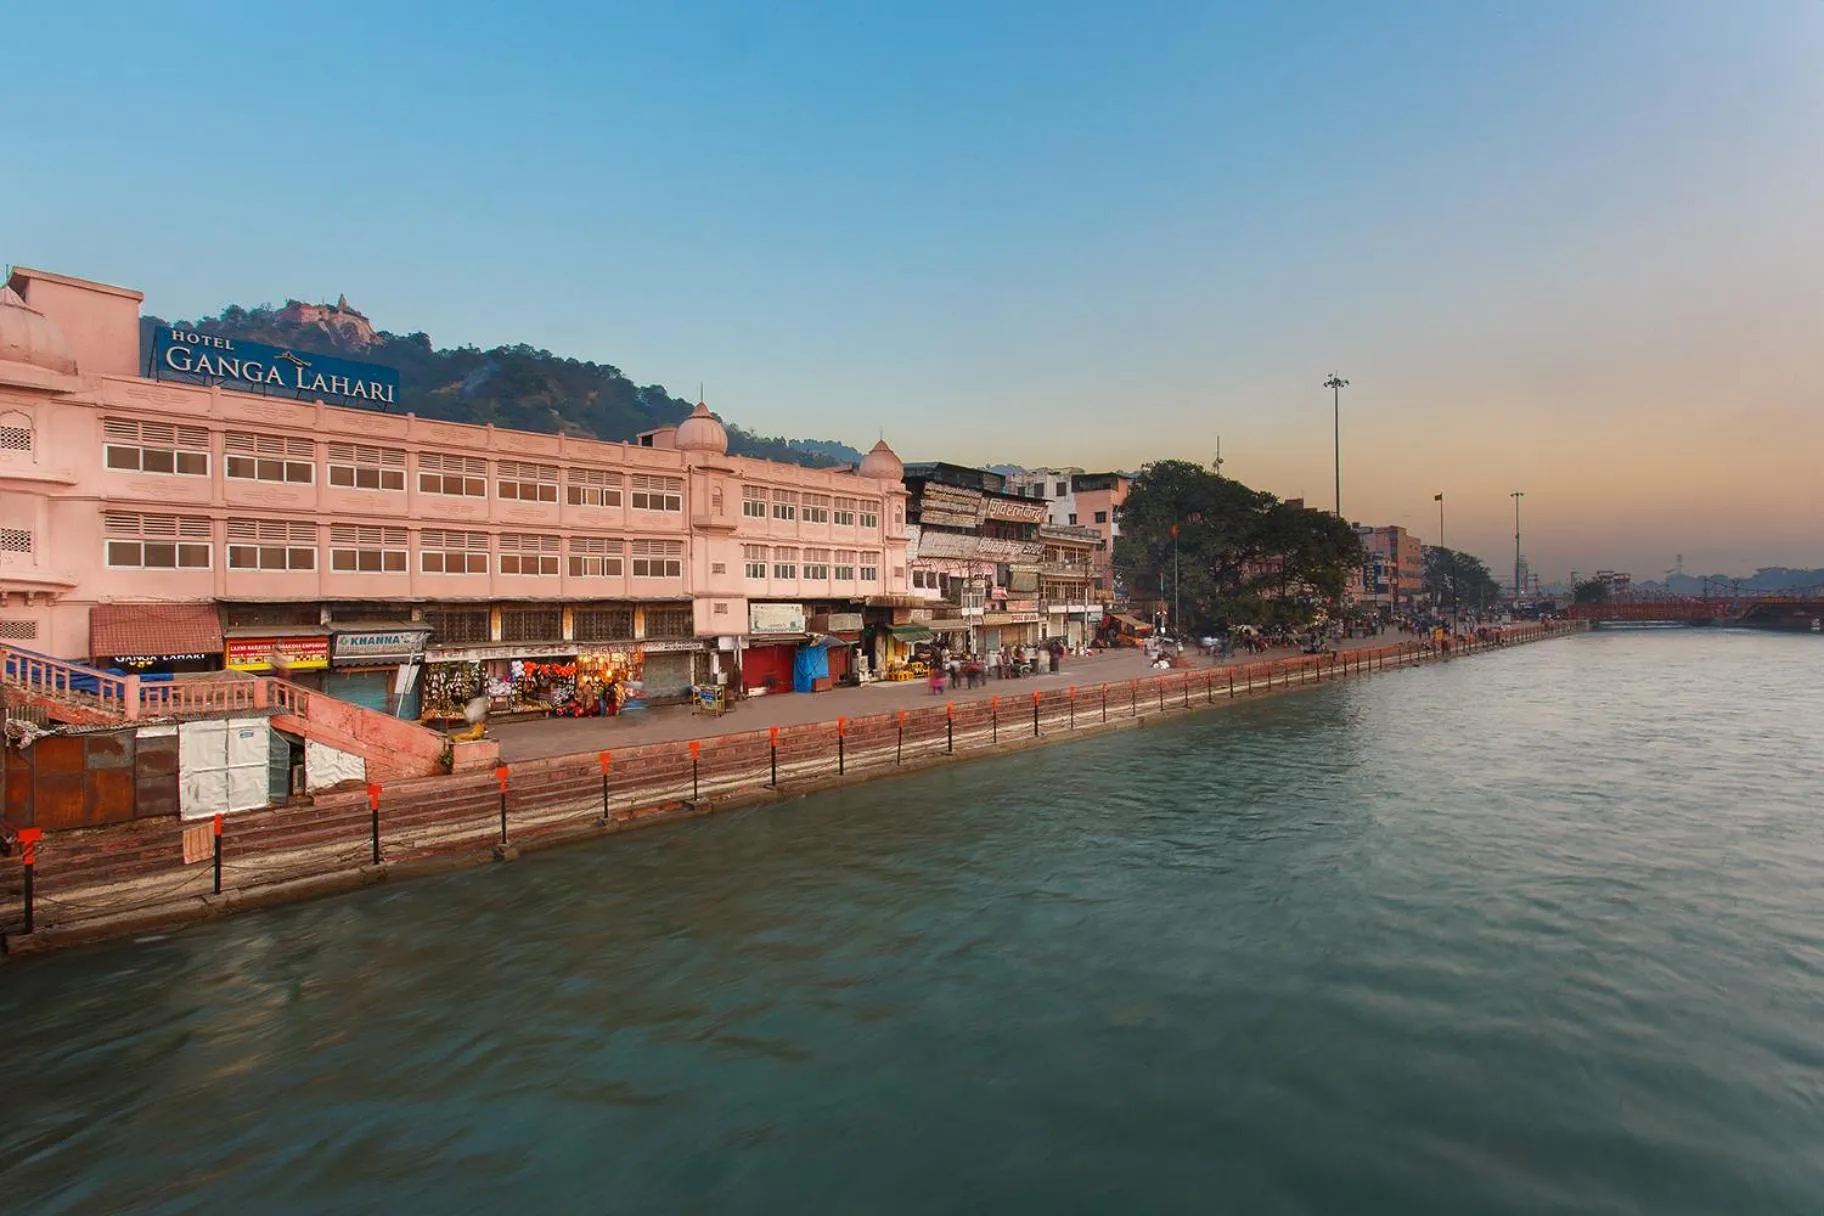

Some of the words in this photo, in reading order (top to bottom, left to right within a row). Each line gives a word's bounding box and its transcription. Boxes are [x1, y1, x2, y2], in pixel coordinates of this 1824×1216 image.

[171, 330, 234, 350] HOTEL
[165, 346, 286, 387] GANGA
[296, 365, 395, 403] LAHARI
